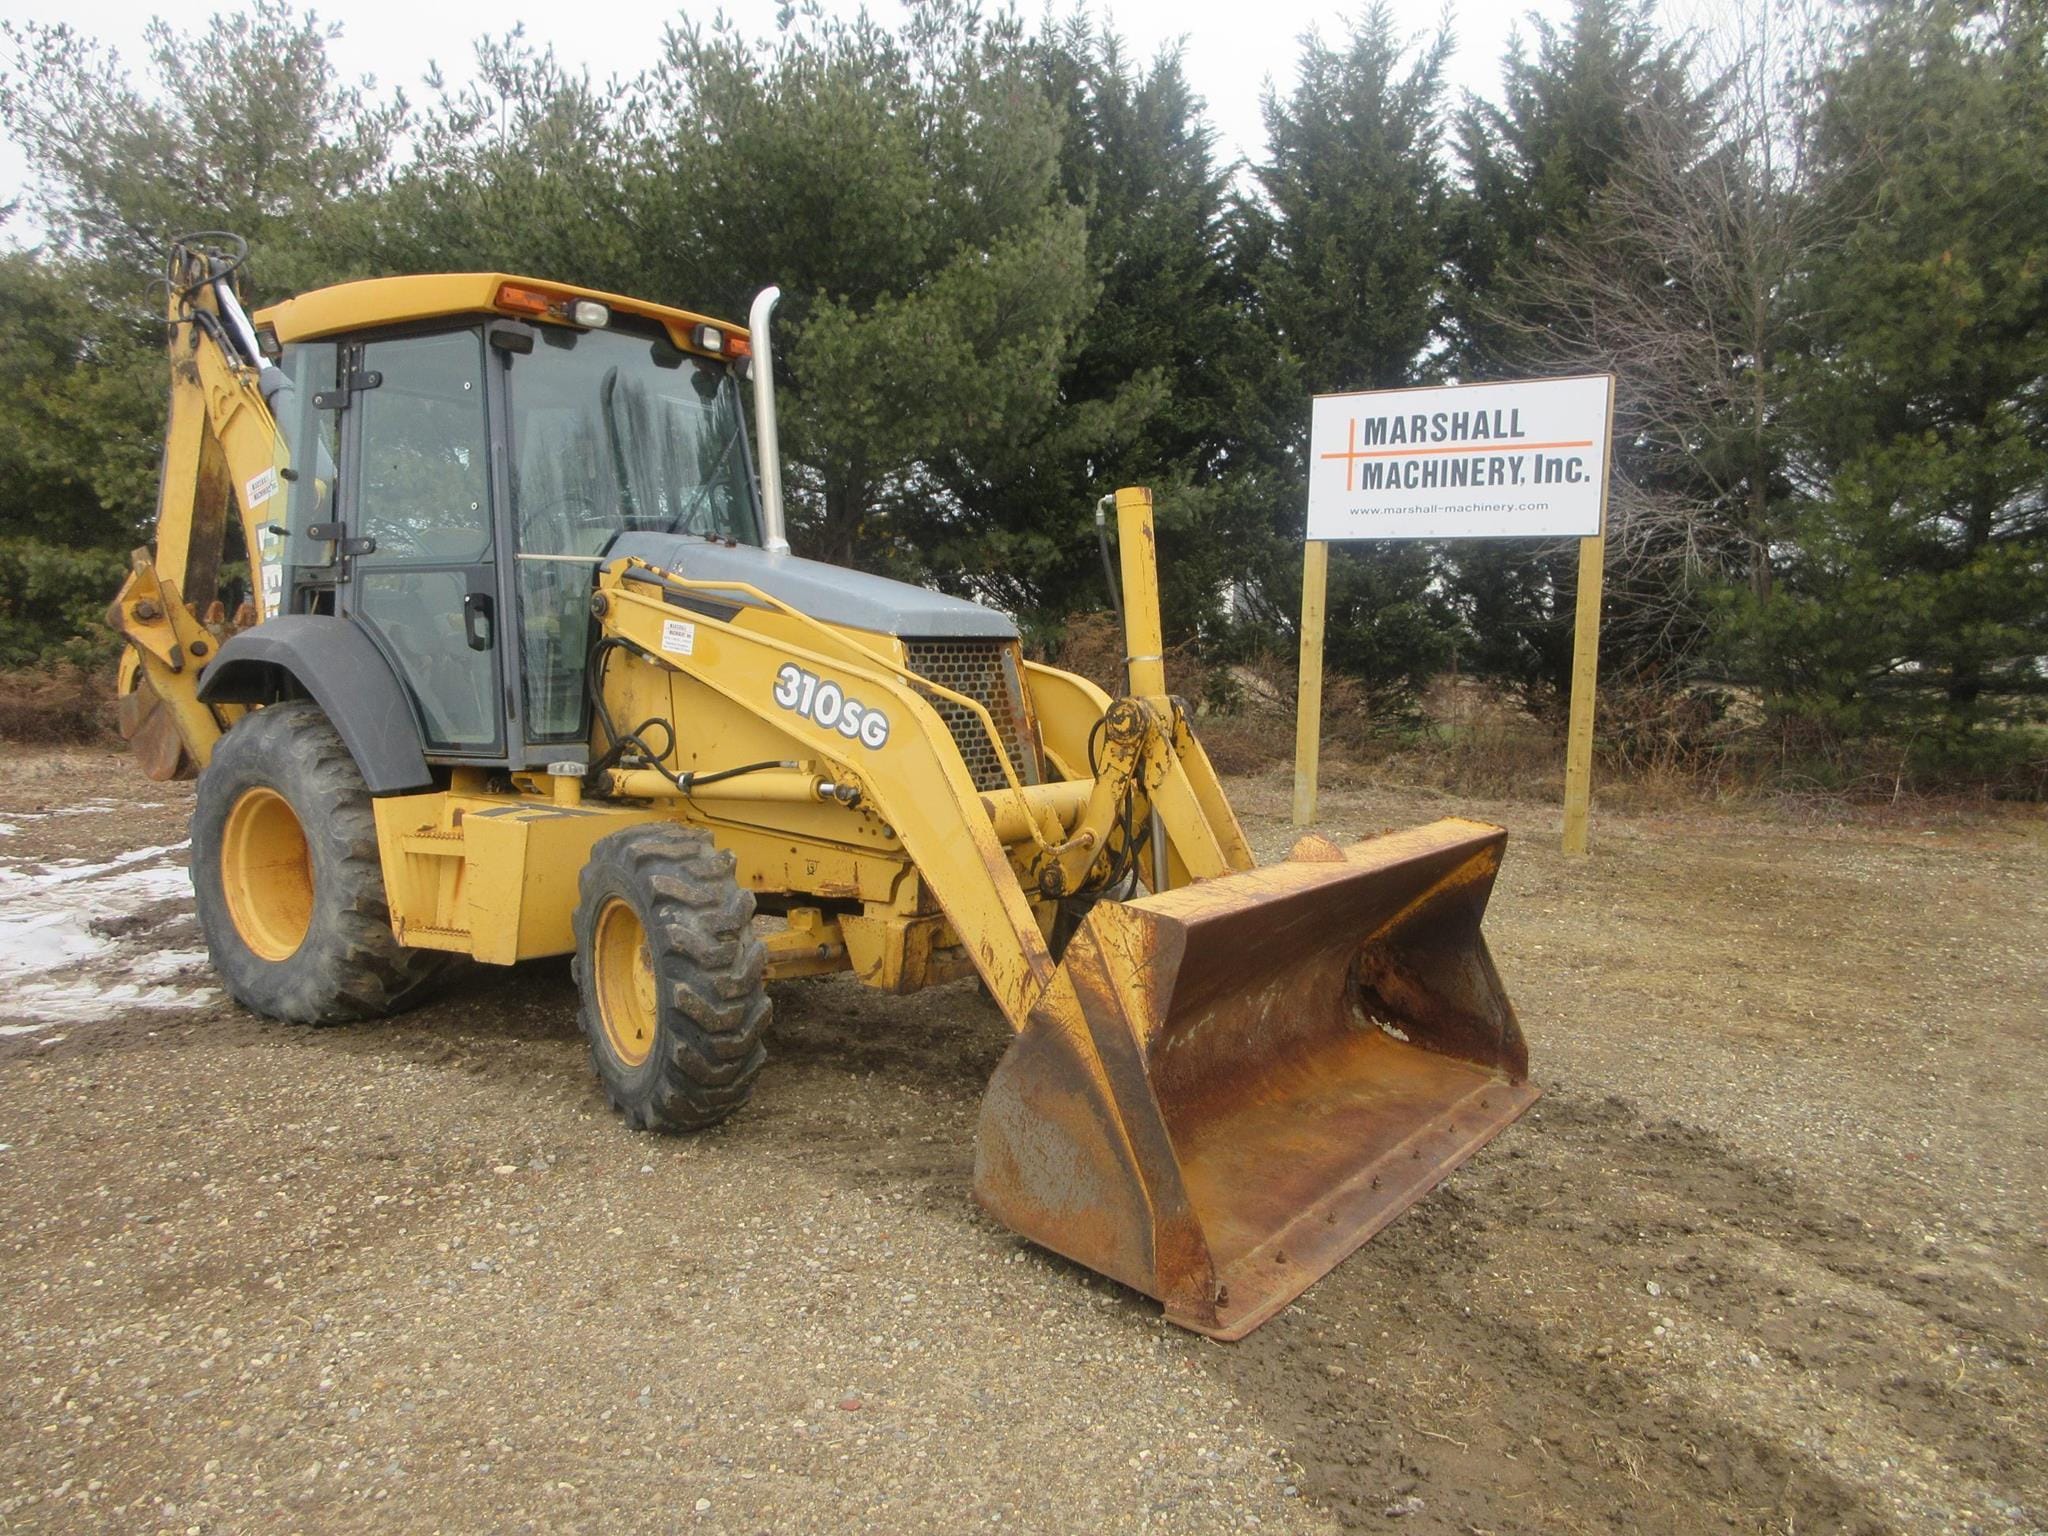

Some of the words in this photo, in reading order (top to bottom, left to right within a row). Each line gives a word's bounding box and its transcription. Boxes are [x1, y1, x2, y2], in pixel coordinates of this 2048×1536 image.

[1364, 408, 1525, 446] MARSHALL
[1362, 456, 1525, 490] MACHINERY,
[1534, 453, 1590, 484] Inc.
[1350, 501, 1549, 515] www.marshall-machinery.com
[774, 663, 889, 749] 310SG
